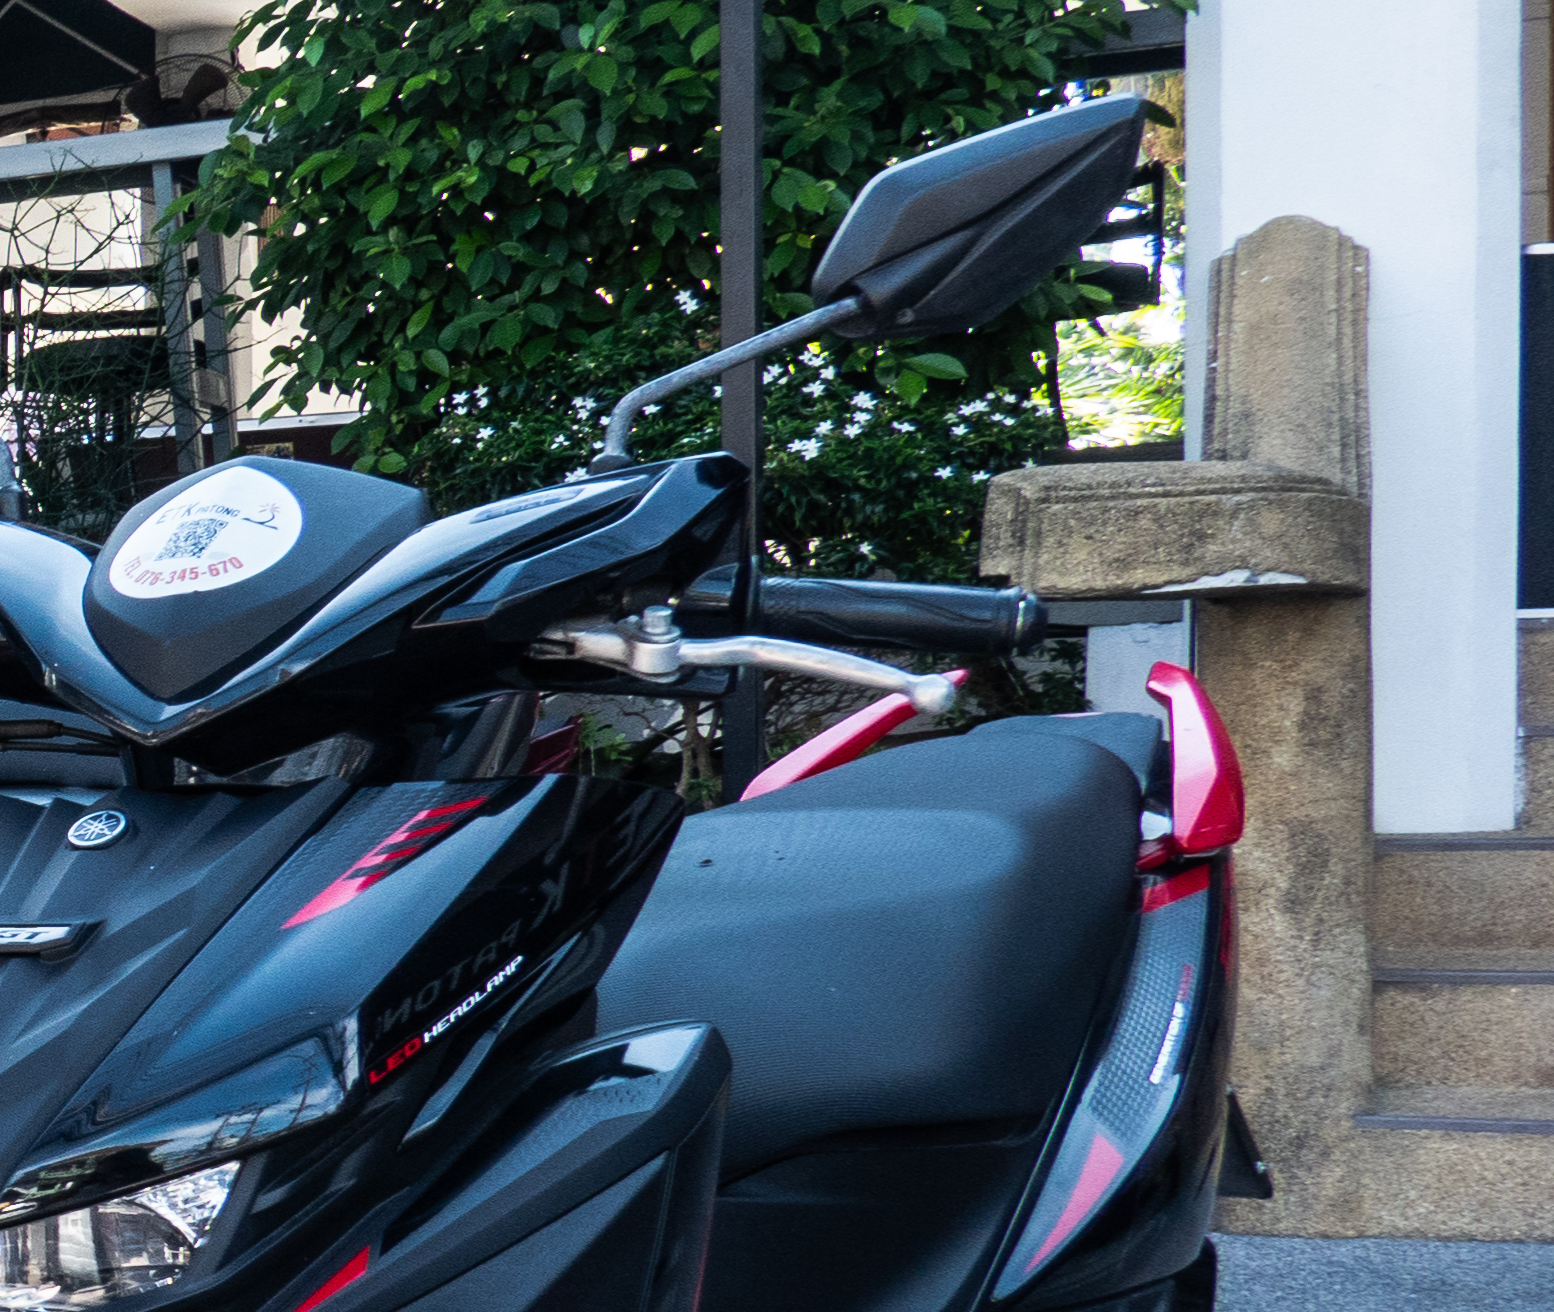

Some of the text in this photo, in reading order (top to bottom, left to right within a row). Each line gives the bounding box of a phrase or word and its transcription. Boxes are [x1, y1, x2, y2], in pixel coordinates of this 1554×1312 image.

[155, 501, 240, 525] ETK PATONG
[368, 954, 525, 1085] LED HEADLAMP
